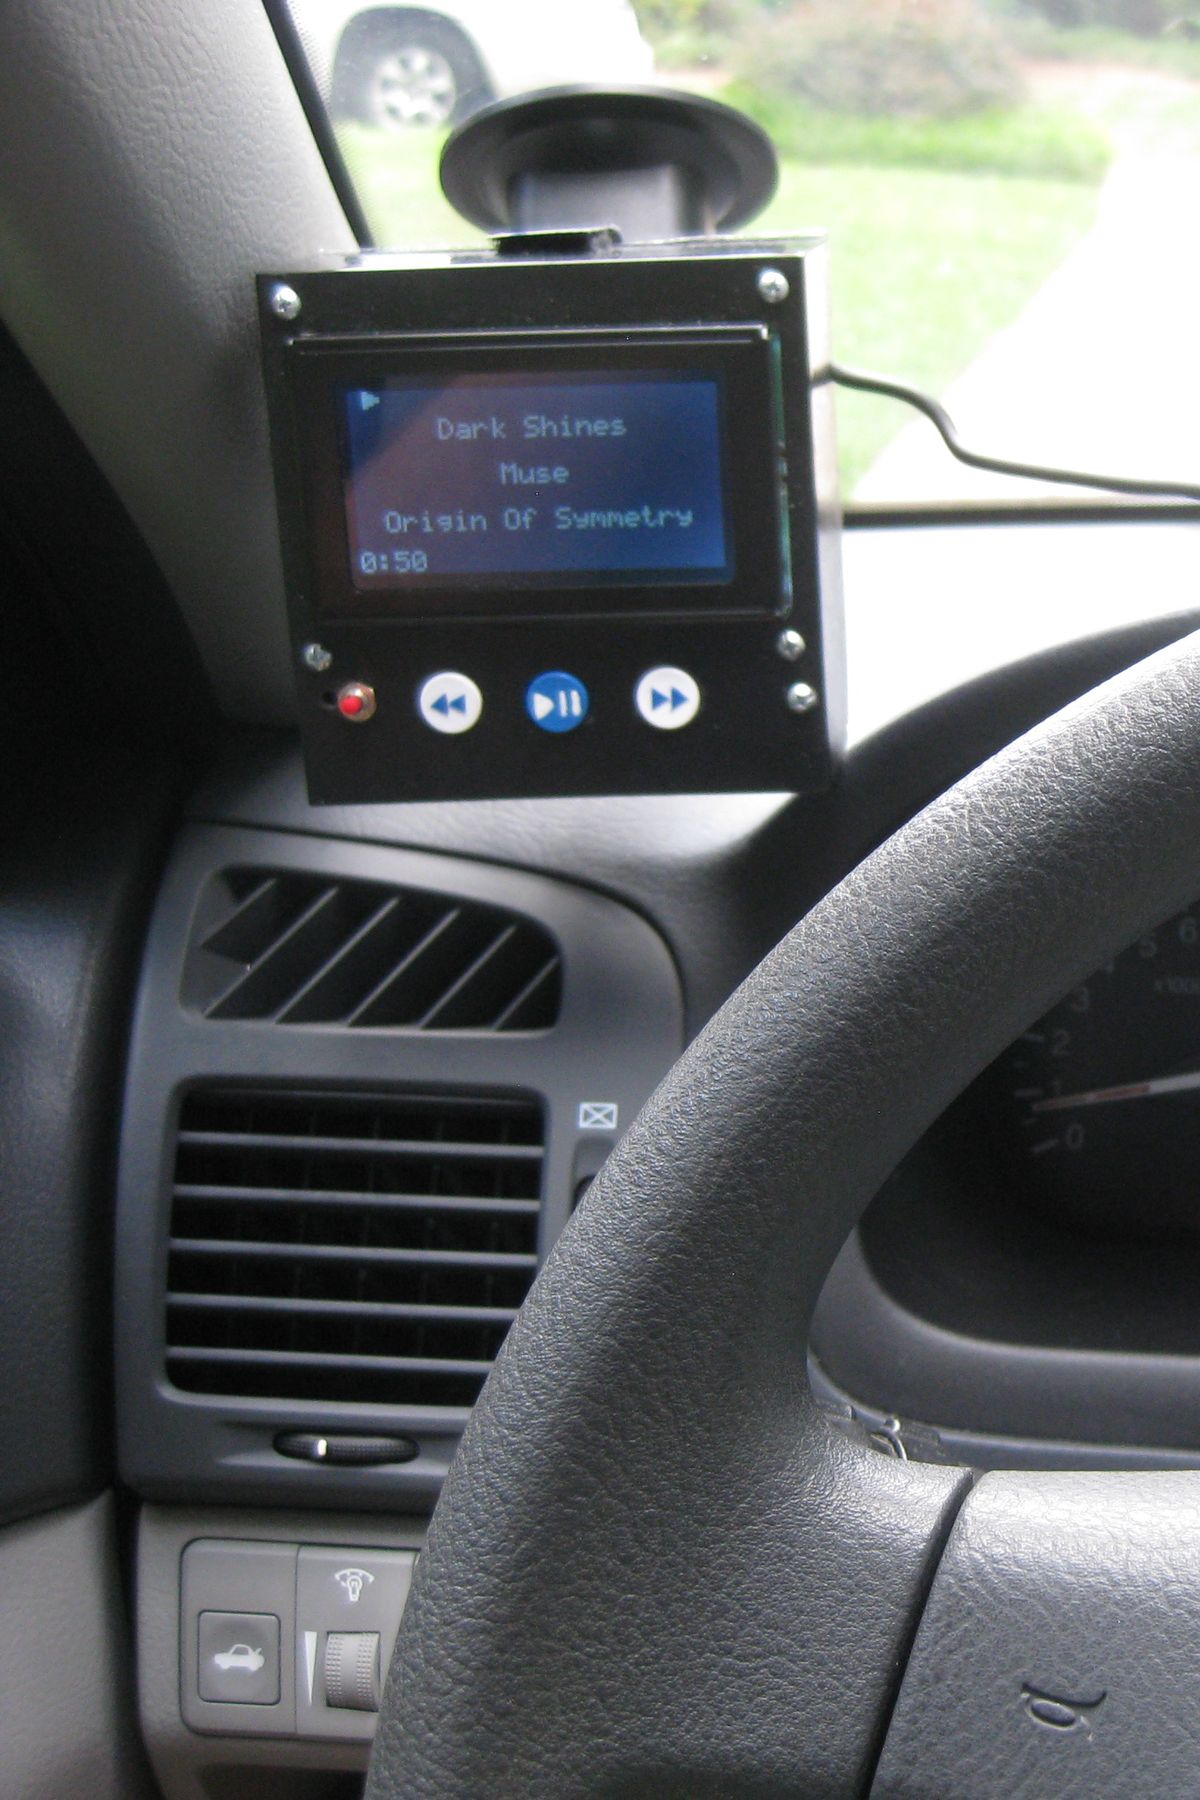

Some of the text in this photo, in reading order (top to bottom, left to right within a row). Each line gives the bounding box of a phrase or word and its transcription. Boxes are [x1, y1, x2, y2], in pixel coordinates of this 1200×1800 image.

[436, 414, 627, 441] Dark Shines
[500, 462, 570, 485] Muse
[384, 505, 694, 534] Origin Of Symmetry
[359, 550, 428, 575] 0:50
[1178, 917, 1199, 943] 6
[1138, 935, 1157, 960] 5
[1051, 1028, 1071, 1057] 2
[1065, 1122, 1085, 1151] 0
